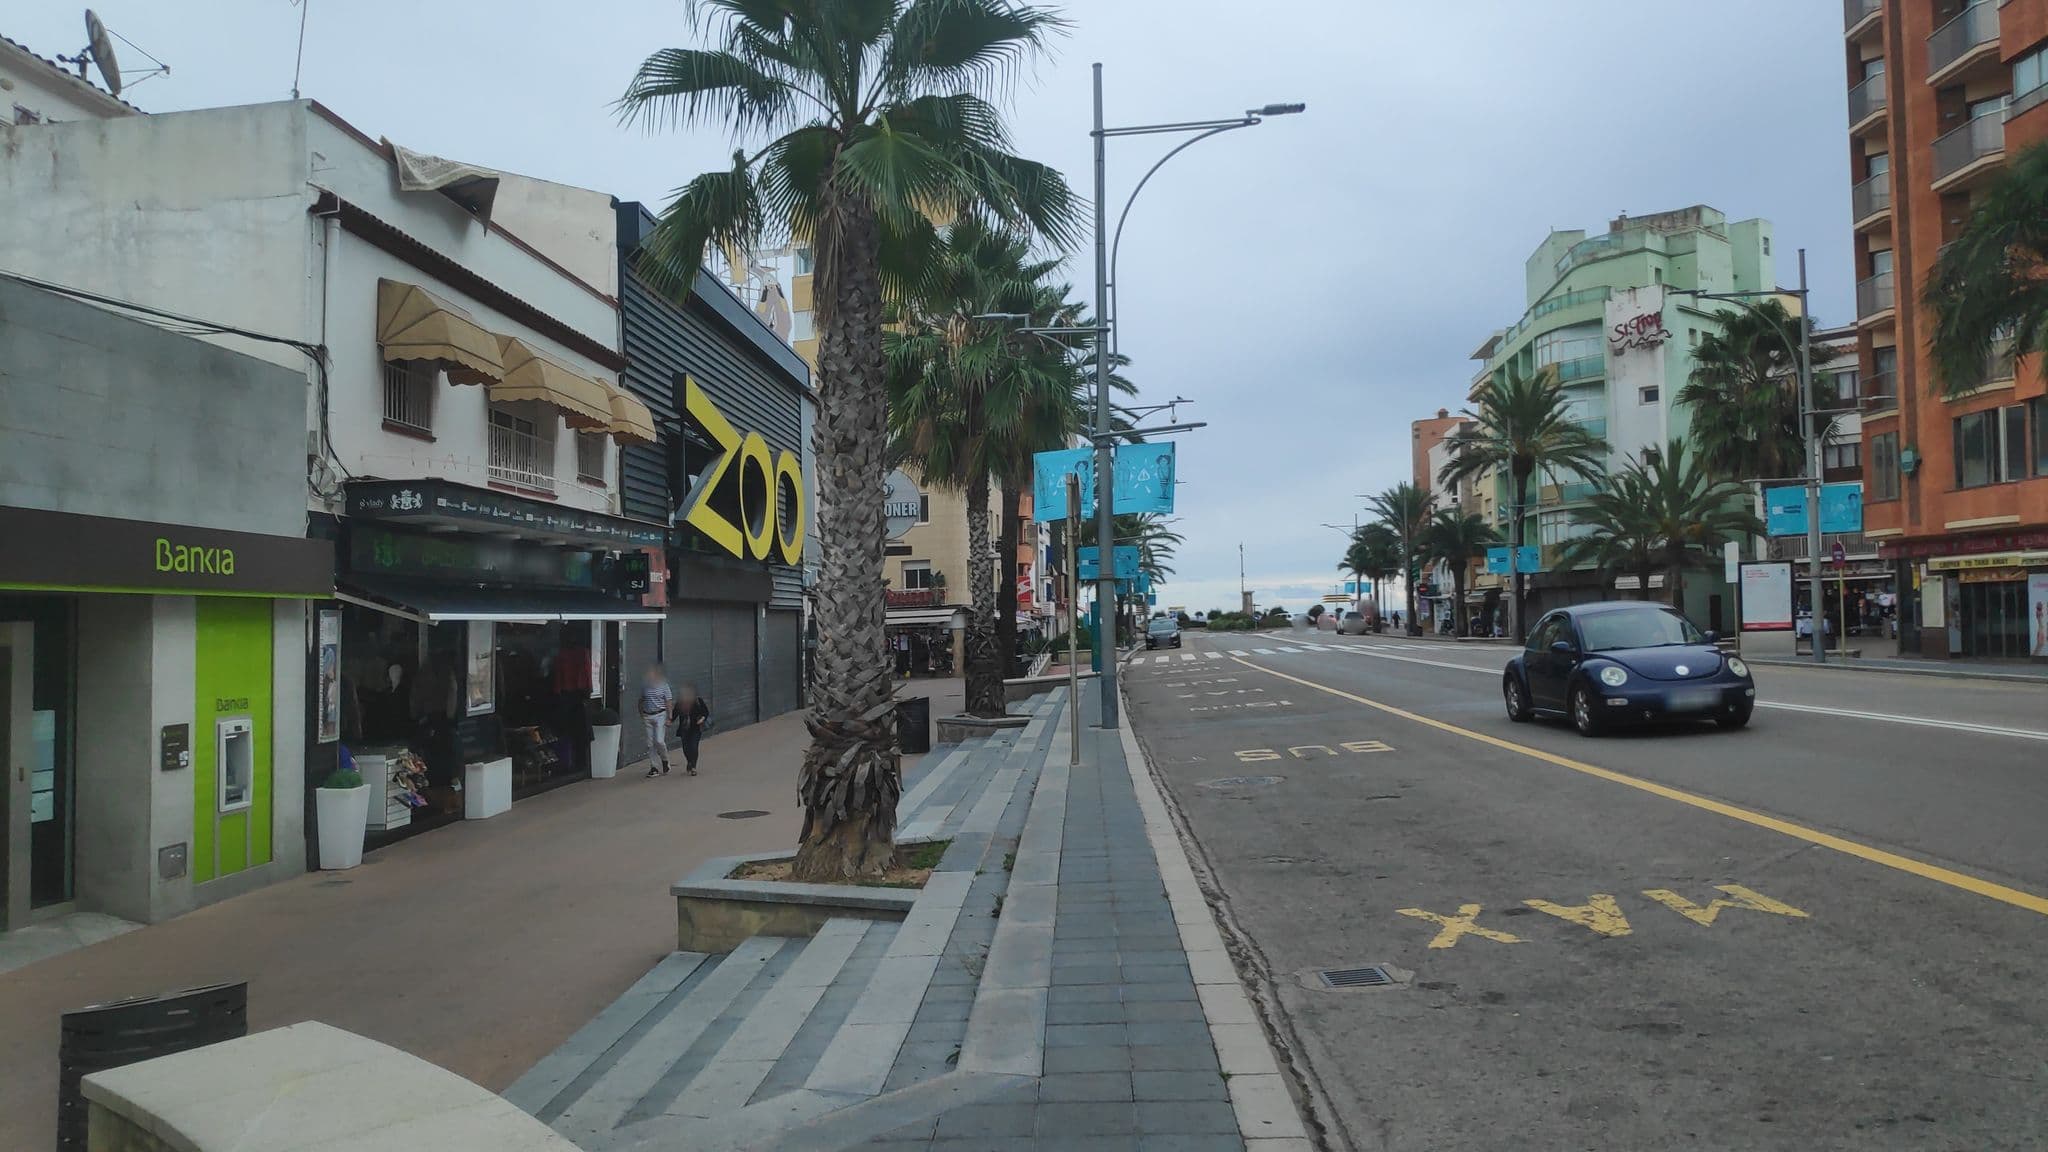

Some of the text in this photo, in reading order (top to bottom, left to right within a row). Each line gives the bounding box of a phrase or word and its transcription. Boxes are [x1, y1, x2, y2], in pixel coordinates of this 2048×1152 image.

[686, 374, 804, 566] ZOO
[884, 502, 917, 517] ONER
[156, 538, 235, 575] Bankia
[630, 580, 645, 589] SJ
[215, 697, 249, 712] Bankia
[1234, 740, 1396, 762] BUS
[1396, 884, 1810, 949] MAX
